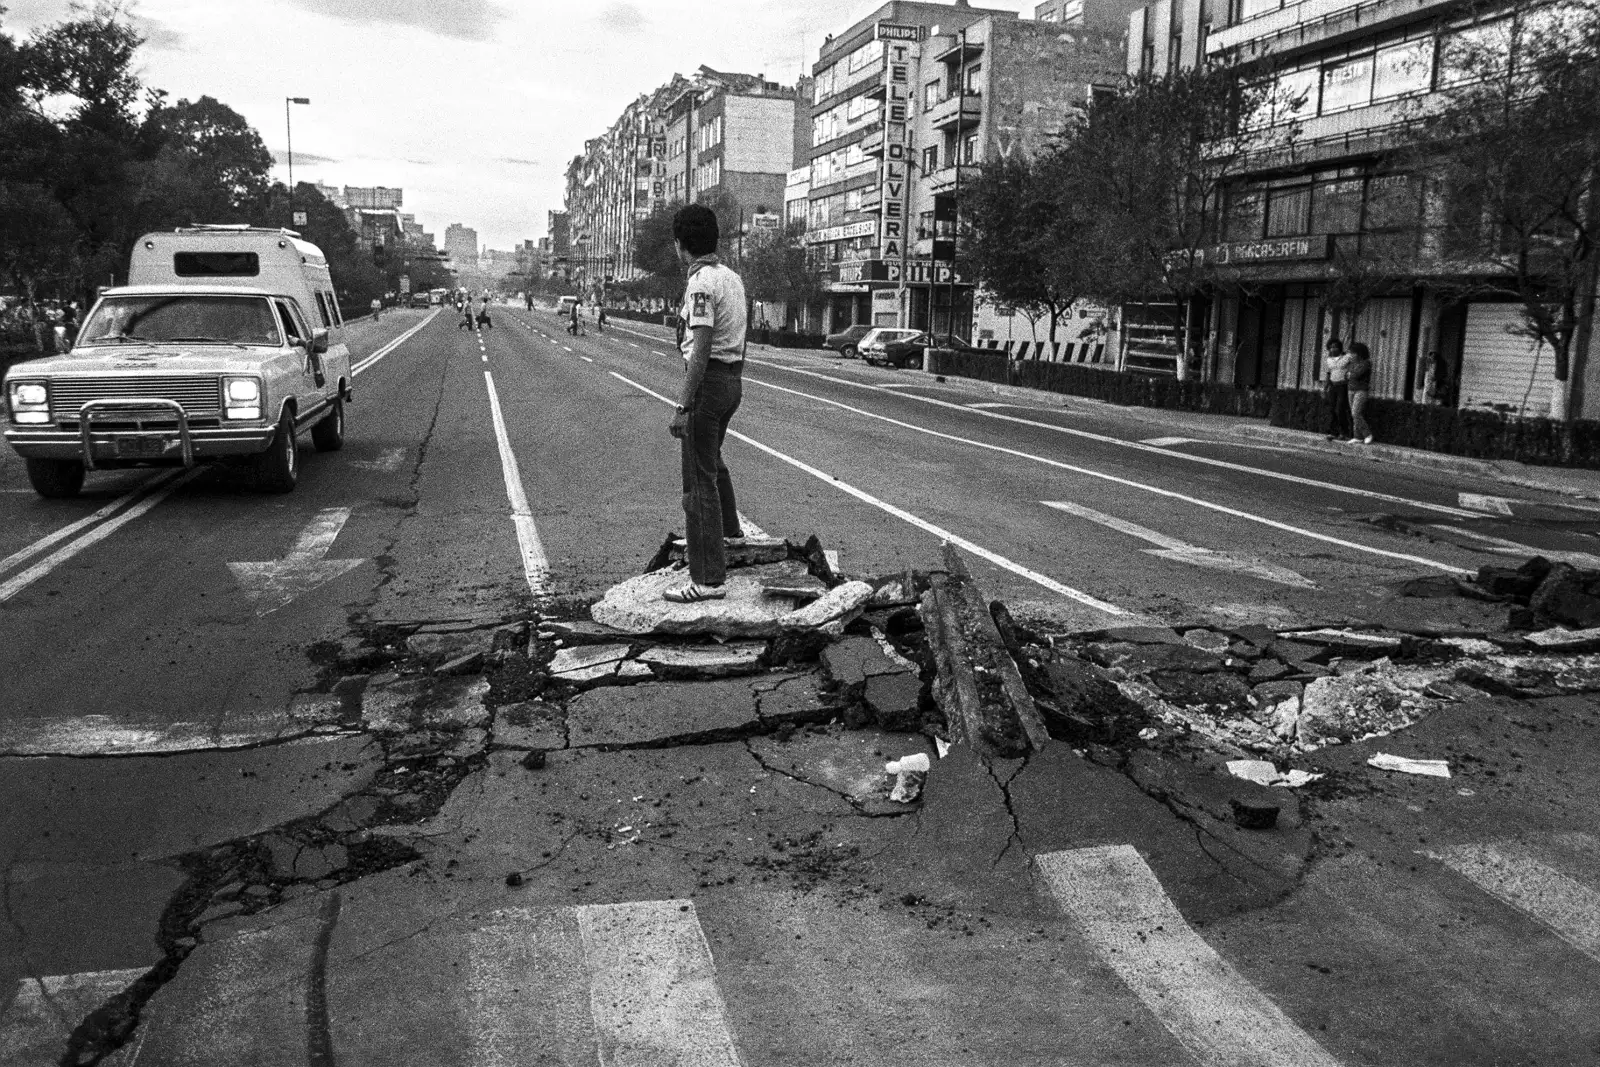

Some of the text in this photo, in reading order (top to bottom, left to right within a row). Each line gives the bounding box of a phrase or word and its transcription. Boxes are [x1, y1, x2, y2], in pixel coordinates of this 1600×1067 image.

[879, 27, 917, 39] PHILIPS
[885, 46, 907, 255] TELE OLVERA
